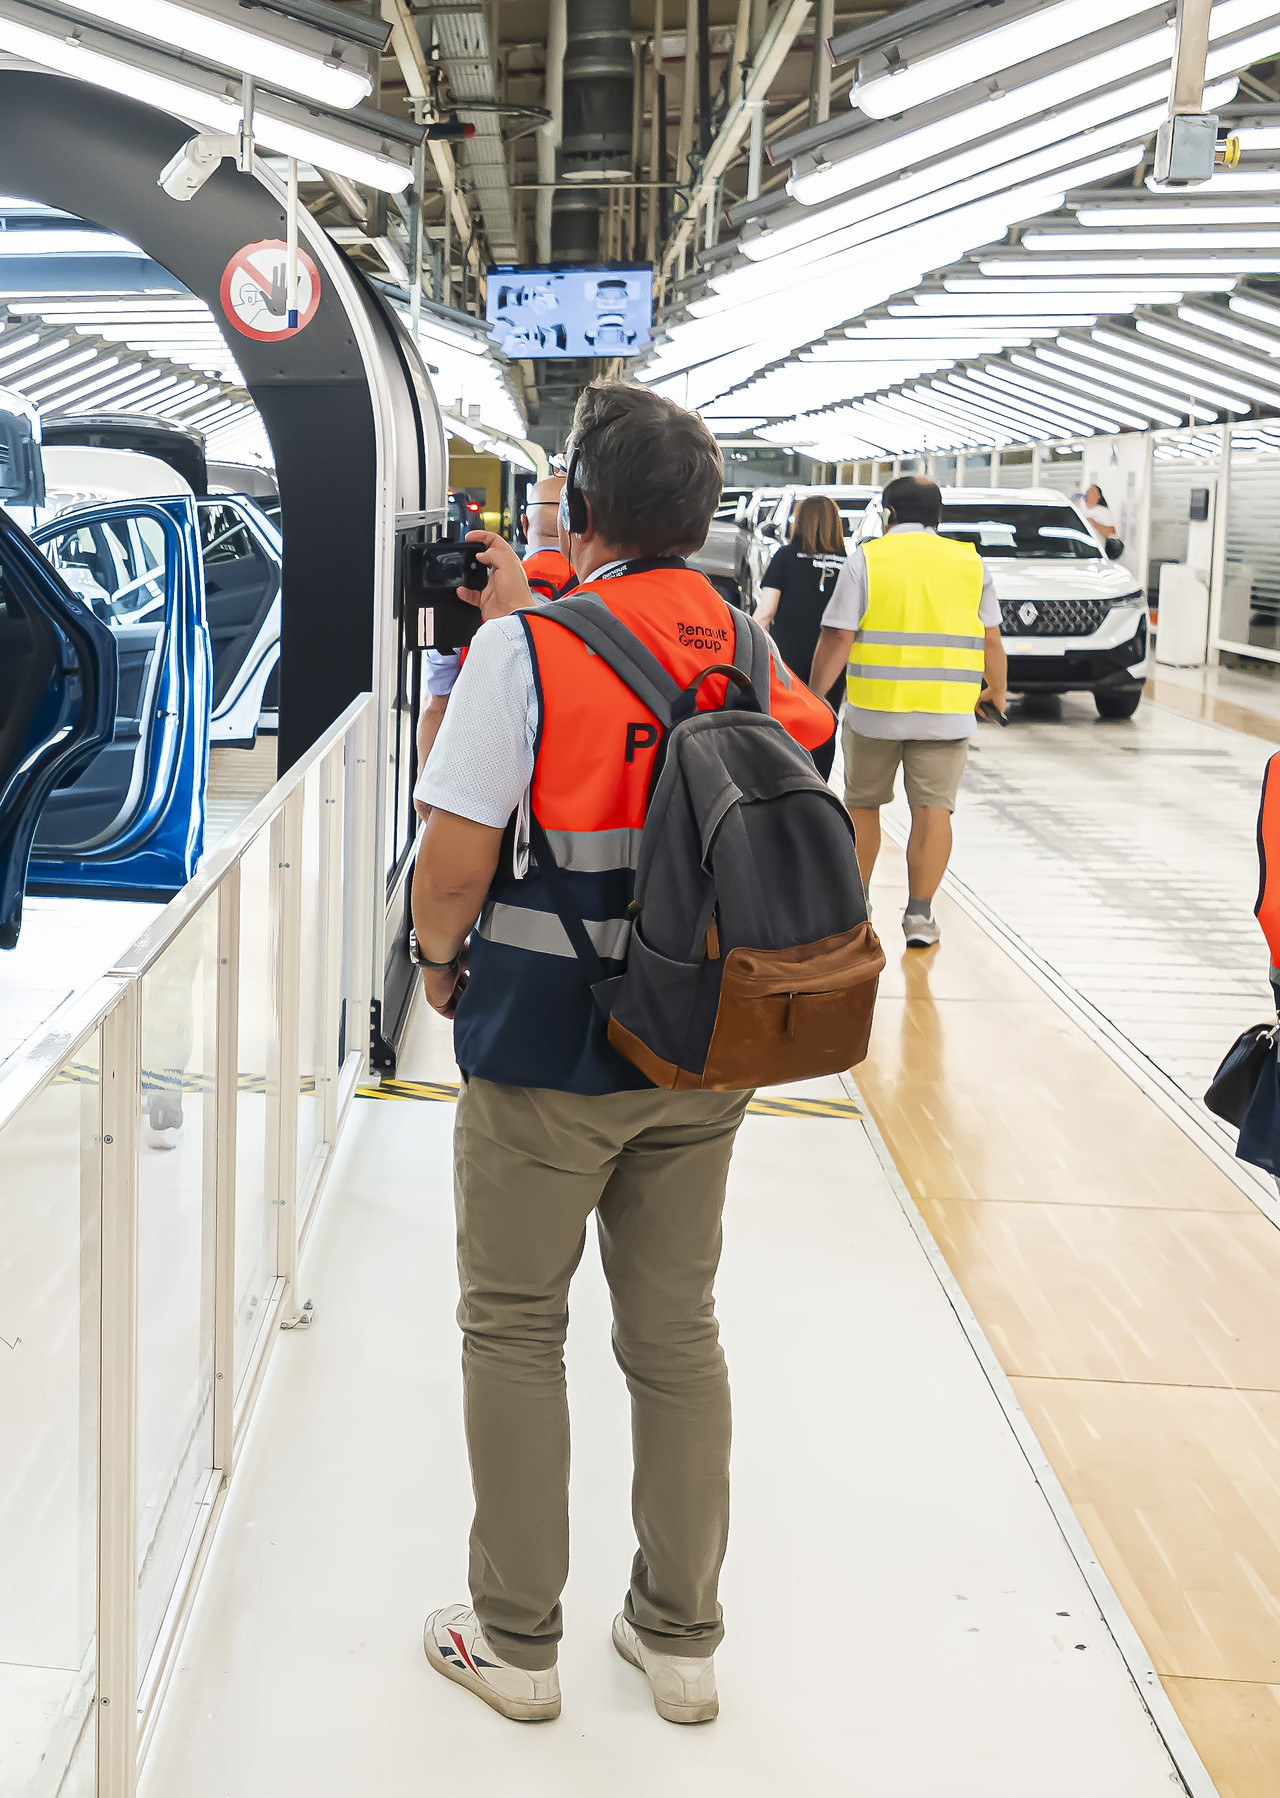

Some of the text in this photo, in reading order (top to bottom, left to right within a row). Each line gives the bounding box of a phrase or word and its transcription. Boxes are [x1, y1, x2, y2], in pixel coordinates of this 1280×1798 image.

[676, 622, 728, 642] Renault
[678, 634, 722, 653] Group
[625, 722, 658, 763] P
